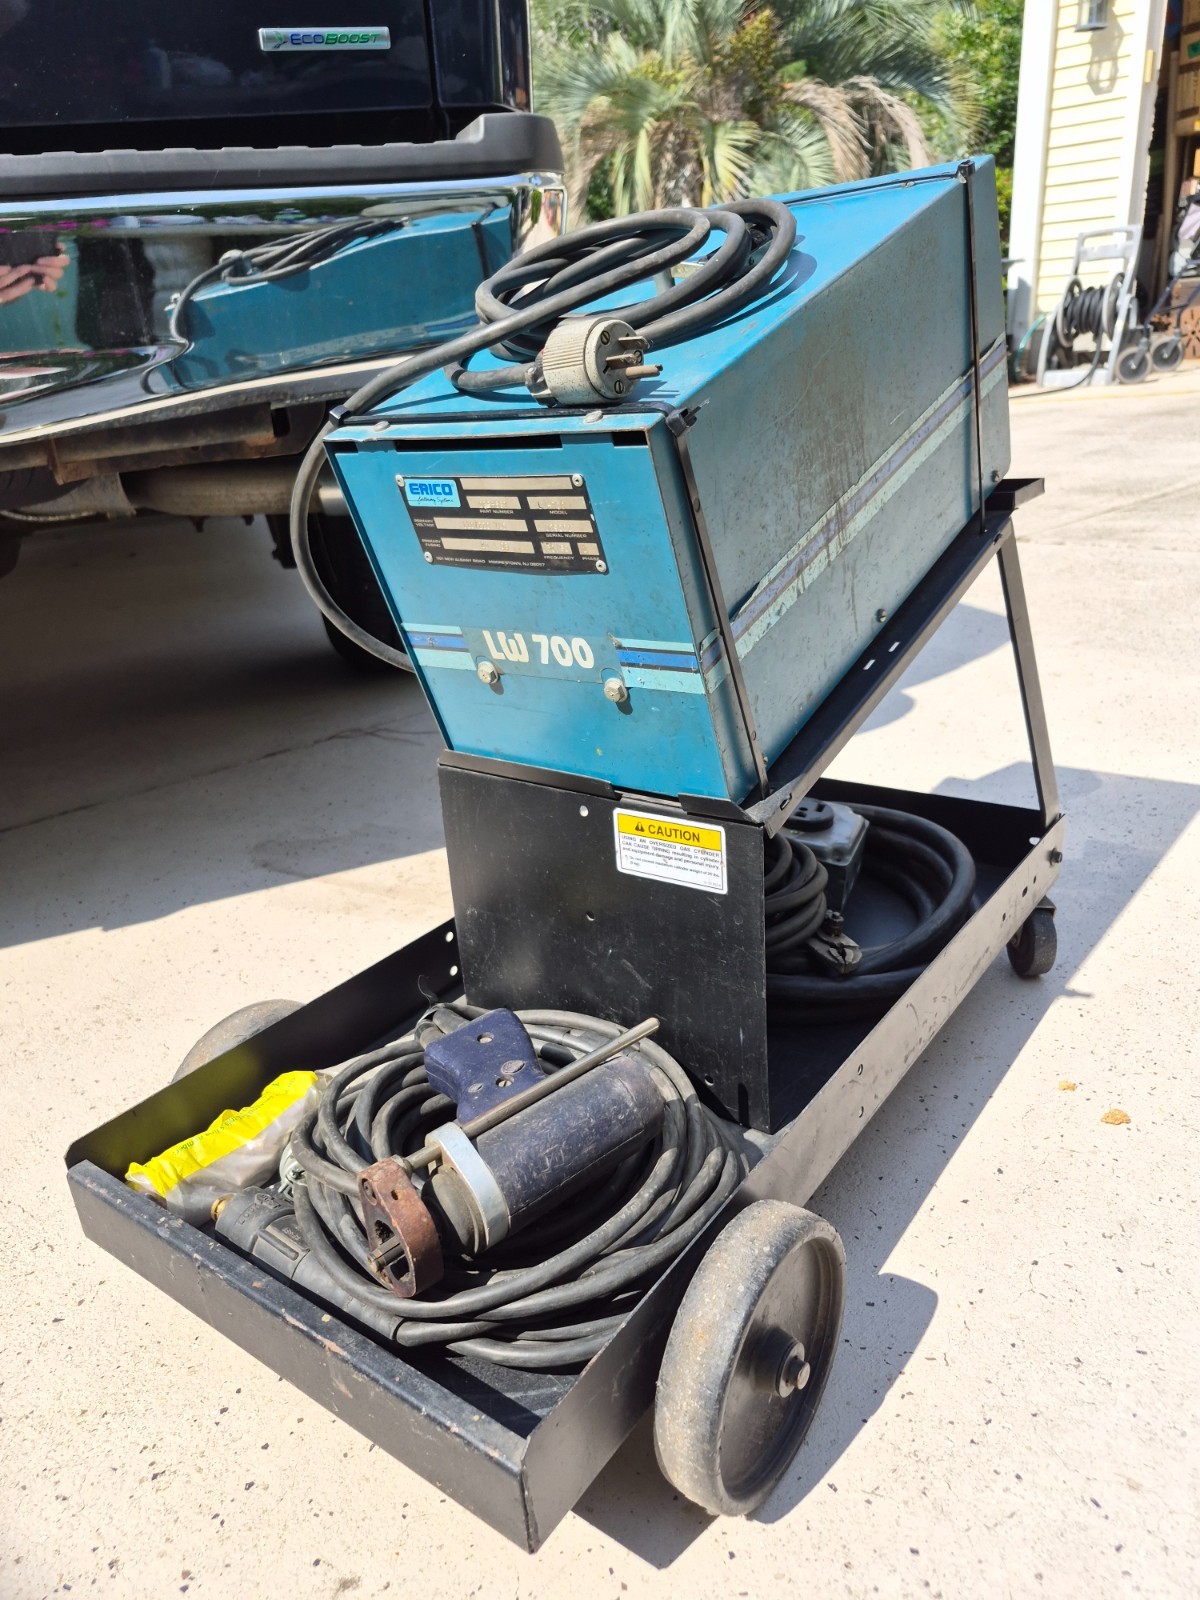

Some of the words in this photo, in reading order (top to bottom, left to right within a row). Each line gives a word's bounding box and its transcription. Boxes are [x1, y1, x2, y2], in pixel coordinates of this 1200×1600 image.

[290, 33, 380, 45] ECOBOOST
[408, 483, 453, 496] ERICO
[482, 630, 529, 663] LW
[531, 633, 595, 669] 700
[648, 824, 700, 843] CAUTION
[631, 848, 655, 858] equipment
[655, 852, 673, 861] damage
[684, 858, 704, 867] personal
[633, 842, 650, 850] CAUSE
[651, 846, 670, 854] TIPPING
[672, 850, 693, 860] resulting
[649, 840, 677, 850] OVERSIZED
[693, 848, 720, 858] CYLINDER
